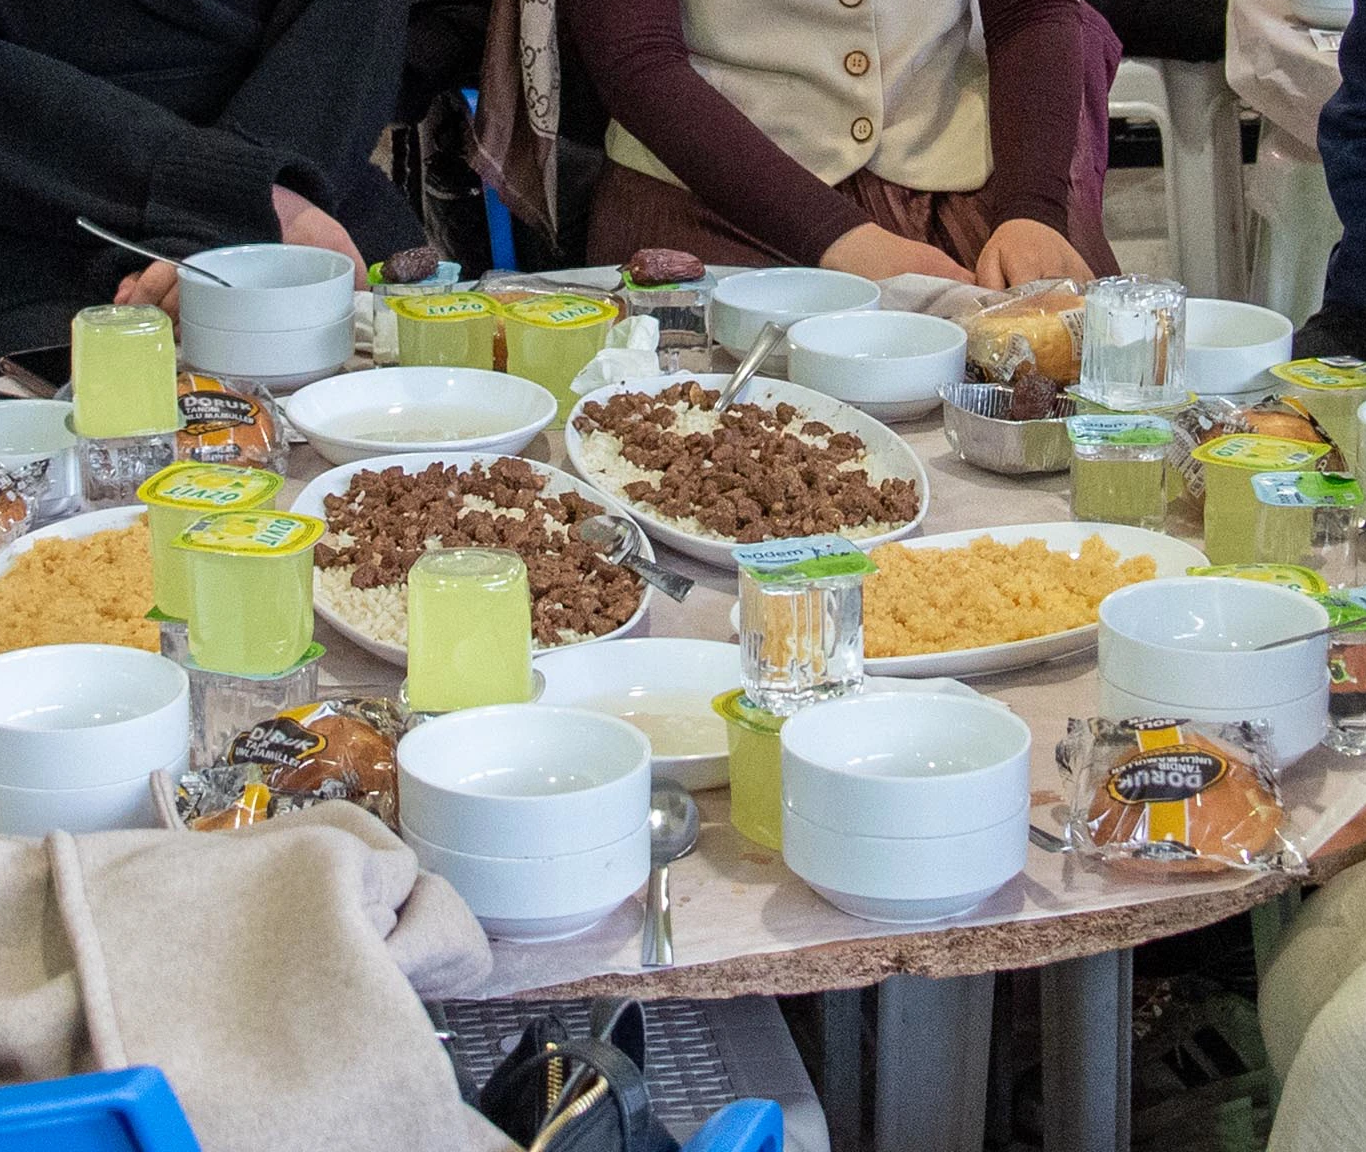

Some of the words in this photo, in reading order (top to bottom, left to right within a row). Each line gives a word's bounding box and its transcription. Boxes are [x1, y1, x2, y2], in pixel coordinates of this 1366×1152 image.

[184, 396, 251, 411] DORUK
[1158, 762, 1202, 773] TANDIR
[1117, 771, 1203, 788] DORUK
